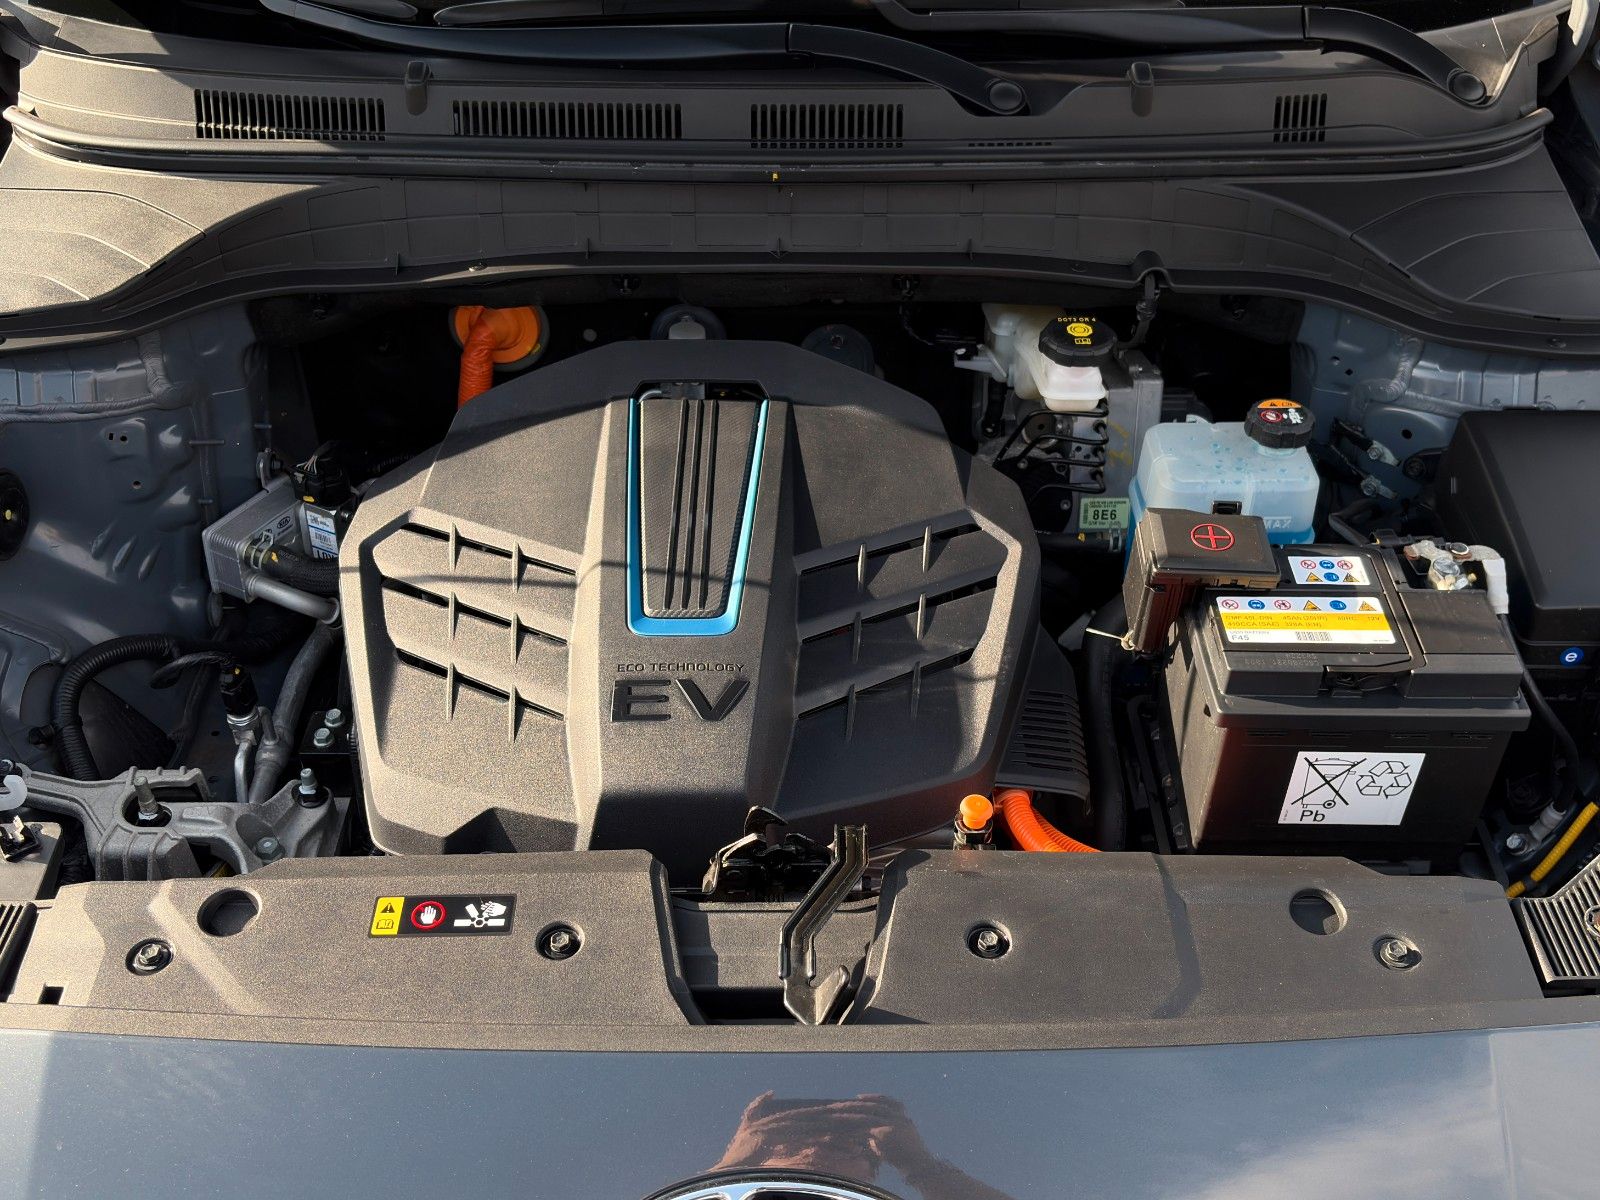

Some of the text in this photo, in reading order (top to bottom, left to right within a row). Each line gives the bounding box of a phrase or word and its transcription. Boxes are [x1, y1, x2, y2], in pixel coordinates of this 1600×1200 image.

[1092, 509, 1118, 521] 8E6
[617, 662, 745, 673] ECO TECHNOLOGY
[610, 679, 751, 722] EV
[1299, 809, 1326, 822] Pb
